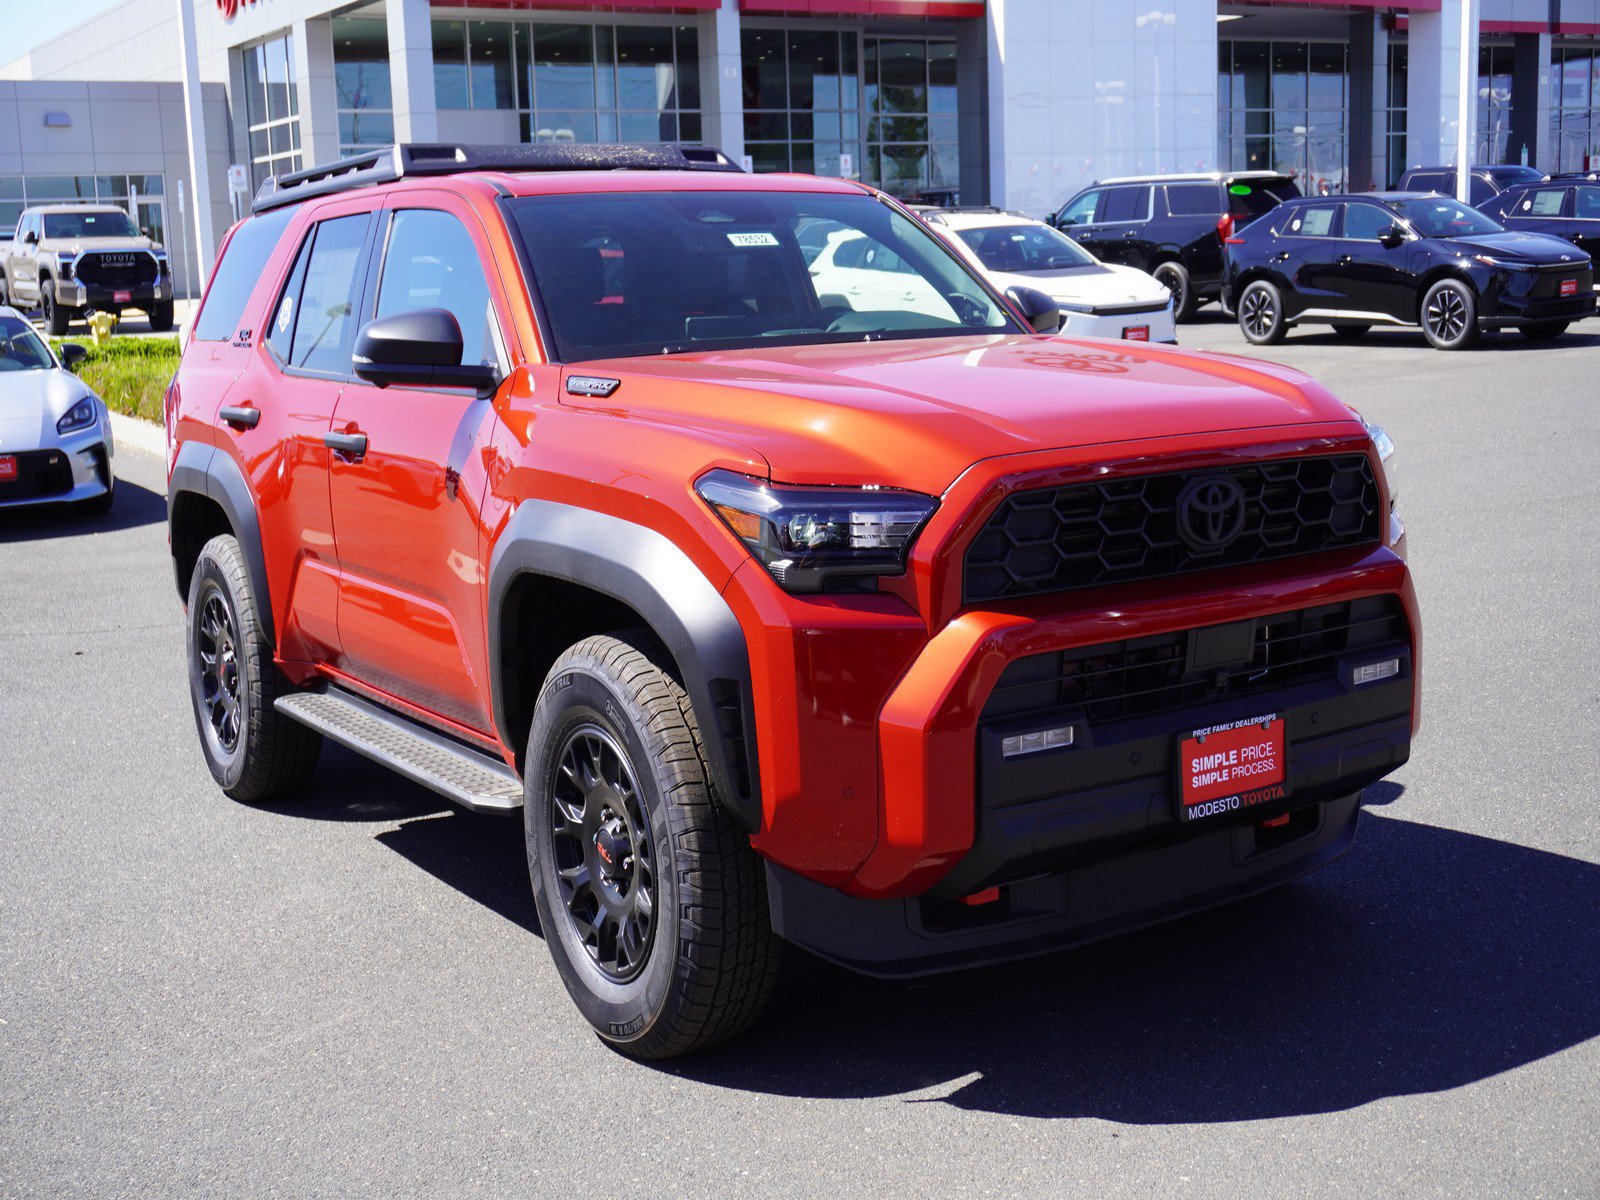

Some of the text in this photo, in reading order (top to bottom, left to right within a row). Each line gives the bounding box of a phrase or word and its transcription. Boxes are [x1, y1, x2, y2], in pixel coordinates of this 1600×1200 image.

[735, 235, 771, 244] 78532
[100, 254, 136, 262] TOYOTA
[1192, 713, 1277, 737] PRICE FAMILY DEALERSHIPS
[1192, 742, 1276, 773] SIMPLE PRICE.
[1192, 759, 1277, 788] SIMPLE PROCESS.
[1188, 786, 1285, 820] MODESTO TOYOTA
